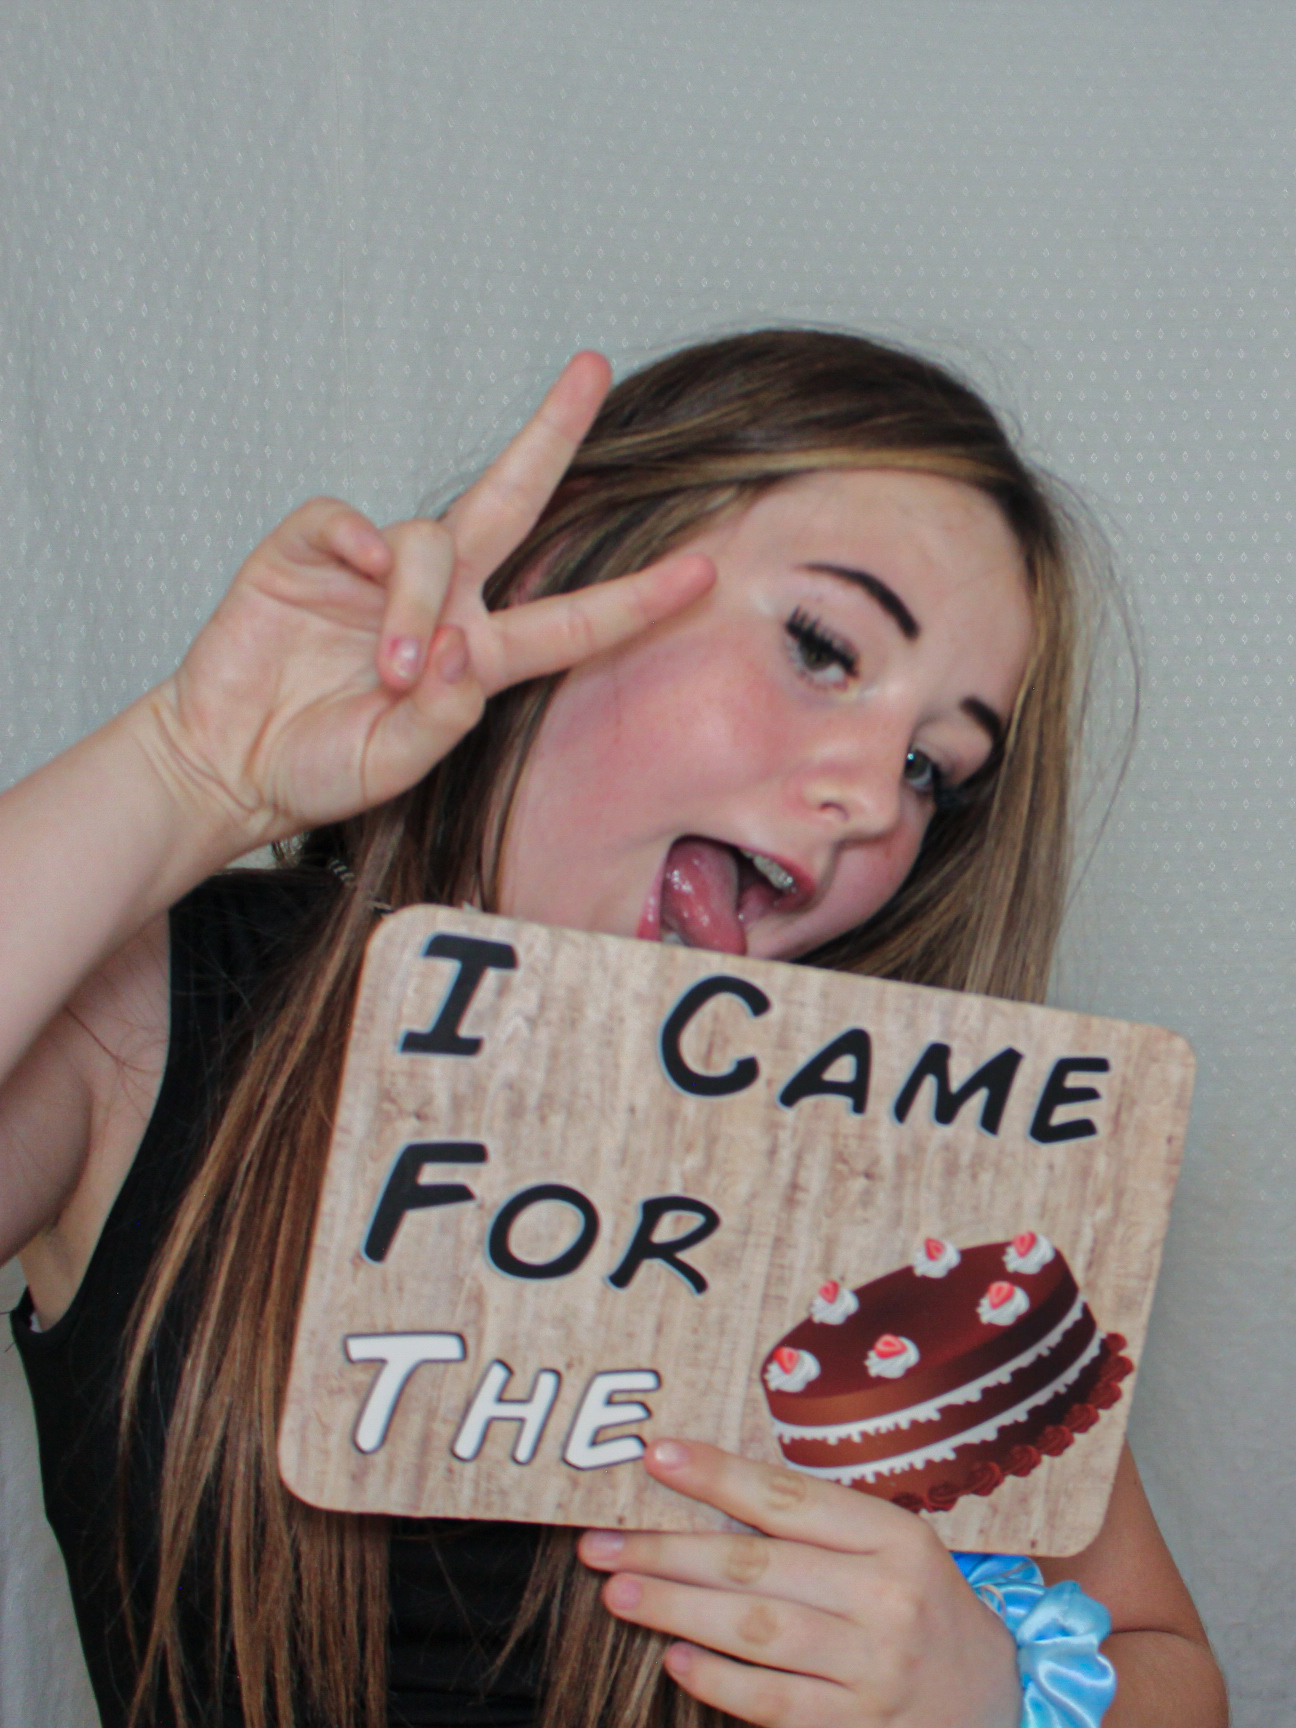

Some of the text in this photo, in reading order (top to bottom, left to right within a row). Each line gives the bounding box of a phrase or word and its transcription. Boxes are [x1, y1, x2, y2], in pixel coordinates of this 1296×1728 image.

[400, 933, 1111, 1144] I CAME
[362, 1142, 721, 1295] FOR
[344, 1331, 662, 1471] THE
